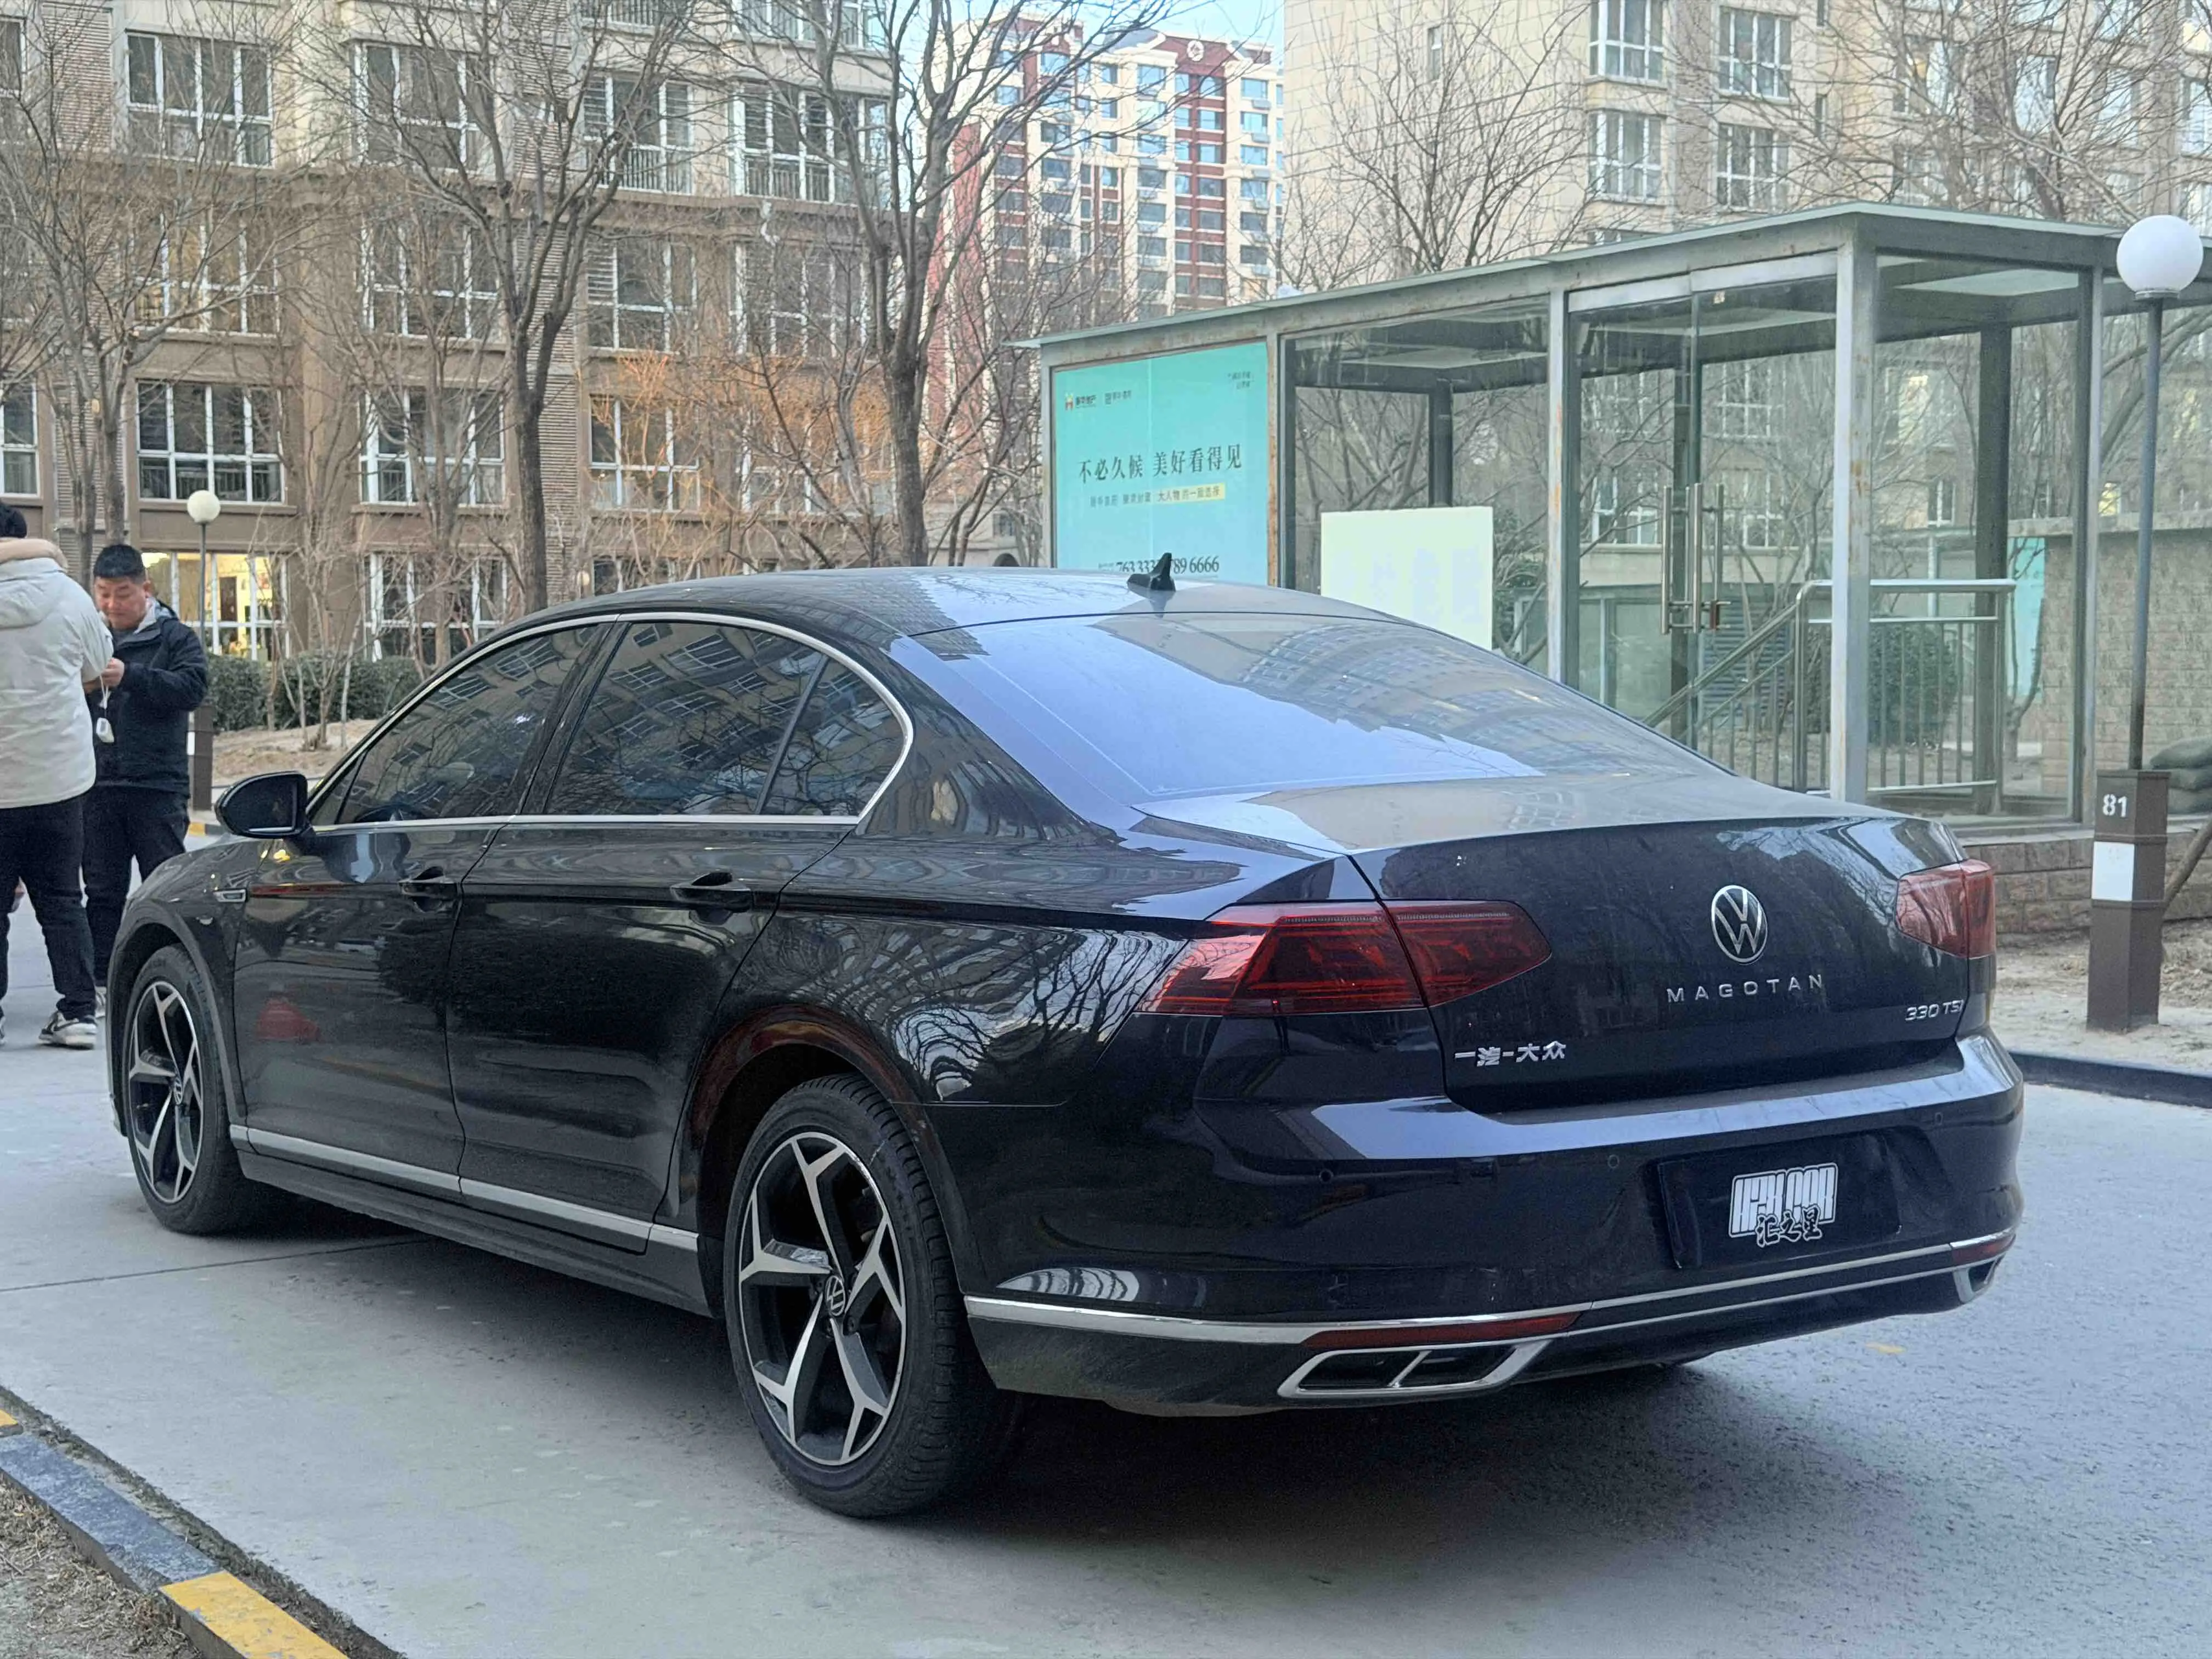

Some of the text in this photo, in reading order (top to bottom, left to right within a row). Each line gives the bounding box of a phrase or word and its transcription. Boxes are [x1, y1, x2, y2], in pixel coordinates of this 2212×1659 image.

[1079, 444, 1243, 484] 不必久候 美好看得见
[1189, 556, 1220, 574] 6666
[2103, 794, 2128, 817] 81
[1667, 974, 1822, 1003] MAGOTAN
[1905, 999, 1965, 1021] 330 TSI
[1454, 1041, 1566, 1067] 一汽-大众
